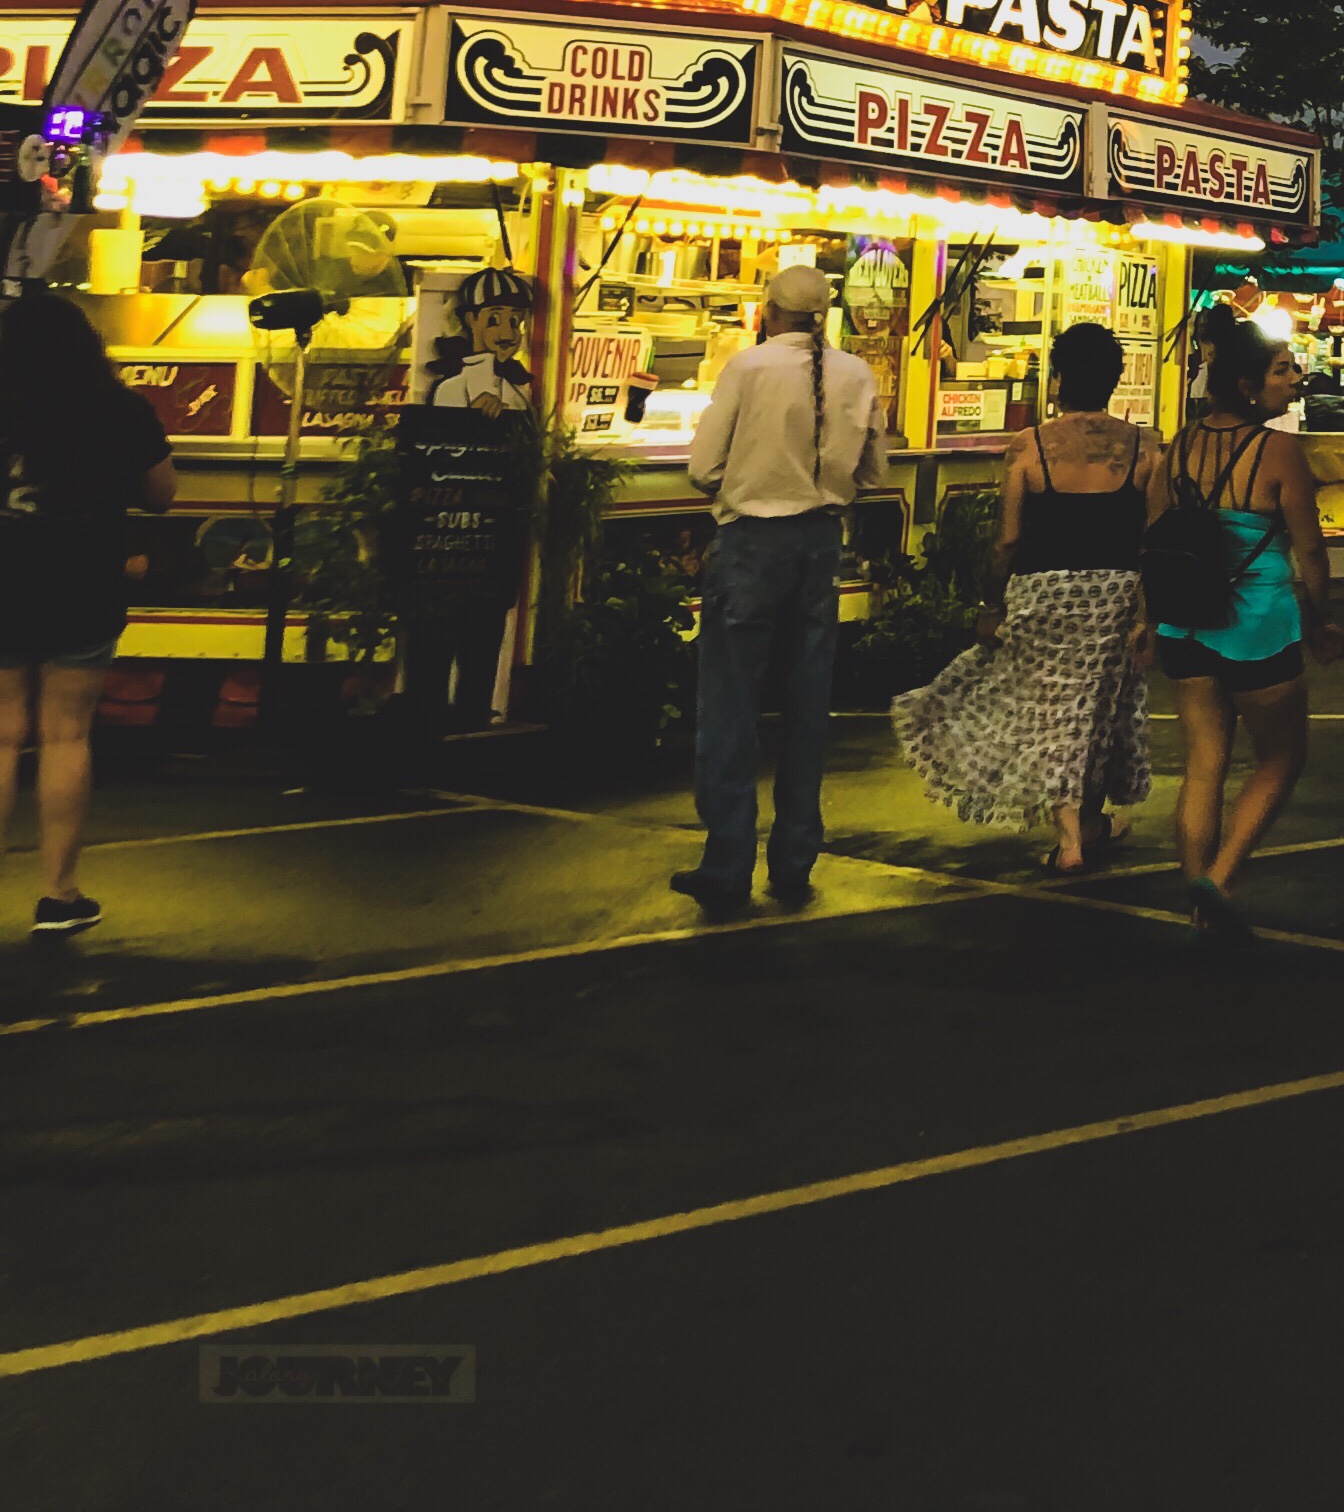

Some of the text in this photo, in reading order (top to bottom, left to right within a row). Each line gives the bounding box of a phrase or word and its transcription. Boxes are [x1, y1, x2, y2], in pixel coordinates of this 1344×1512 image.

[0, 43, 302, 103] IZA
[571, 44, 644, 82] COLD
[548, 84, 660, 122] DRINKS
[857, 91, 1029, 170] PIZZA
[1155, 144, 1273, 206] PASTA
[1118, 262, 1158, 310] PIZZA
[570, 336, 641, 380] OUVENIR
[941, 405, 982, 418] ALFREDO
[943, 392, 982, 405] CHICKEN
